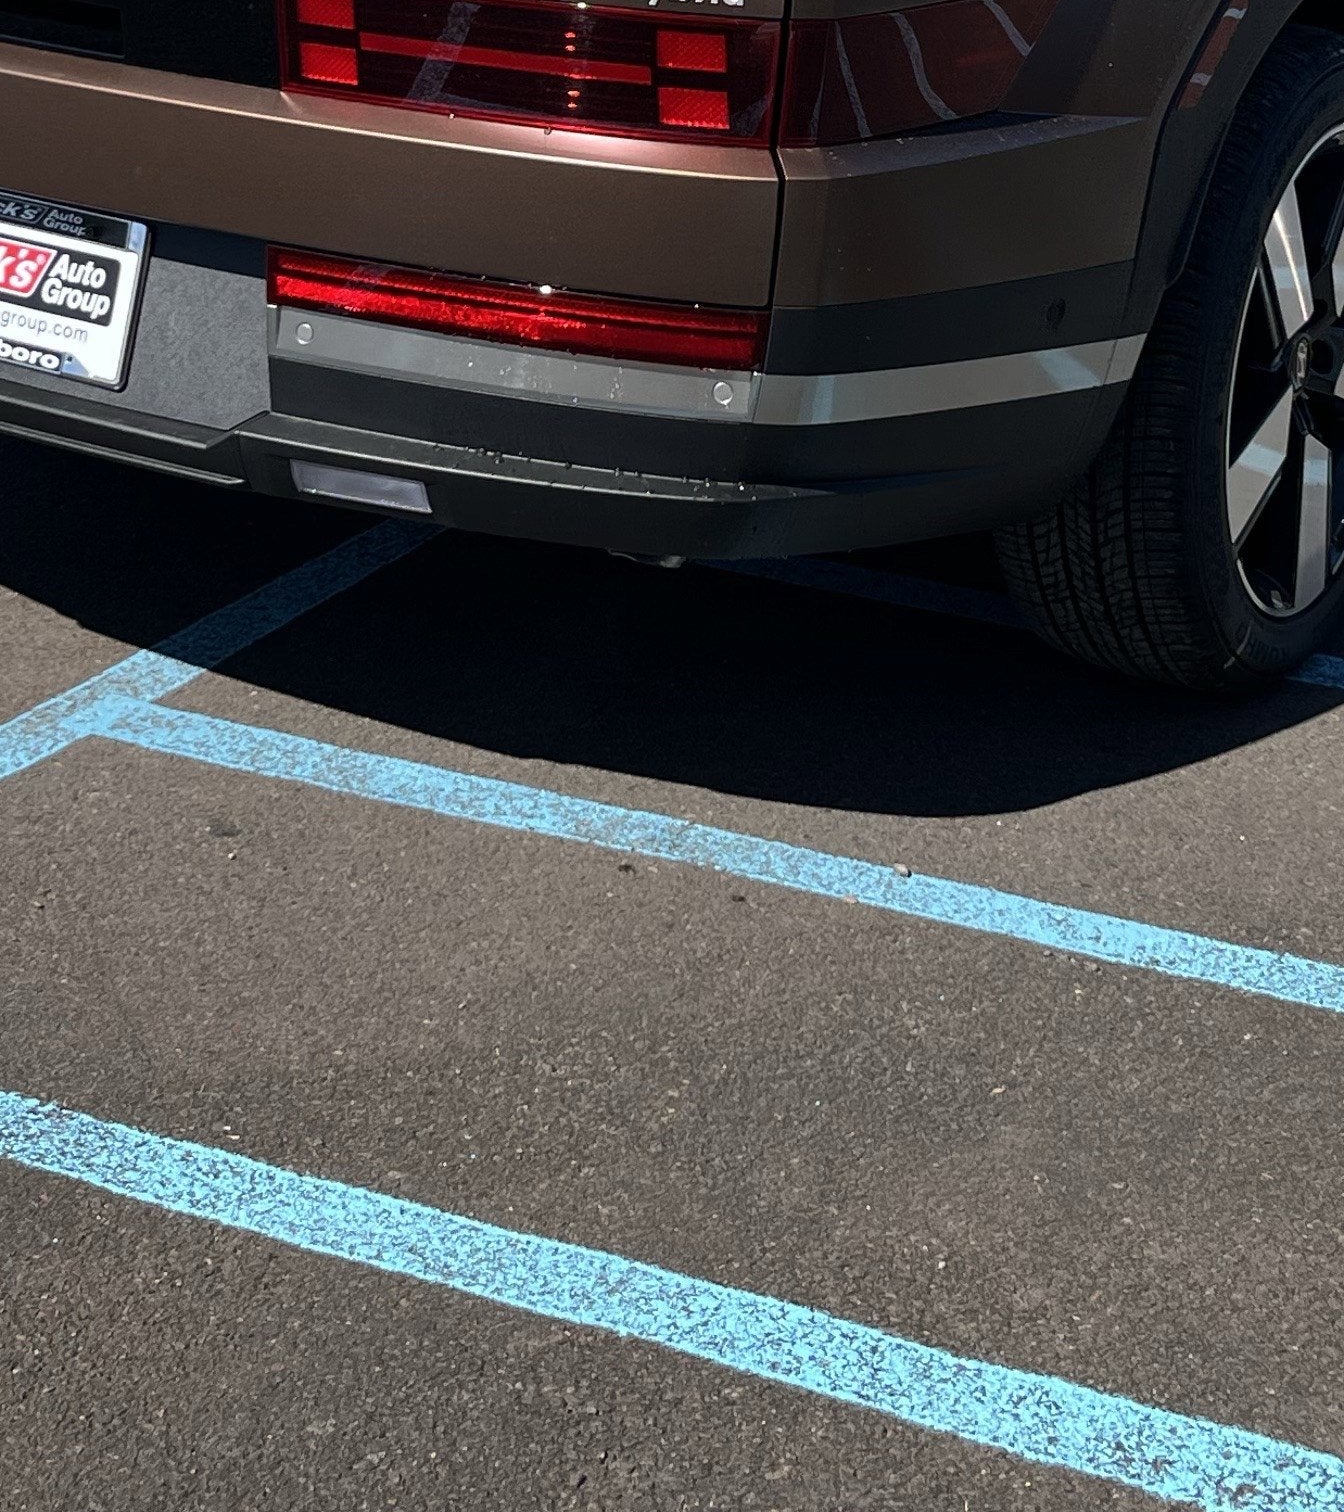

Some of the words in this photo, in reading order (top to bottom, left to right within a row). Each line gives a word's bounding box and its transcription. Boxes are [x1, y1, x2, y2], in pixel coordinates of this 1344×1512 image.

[47, 209, 84, 224] Auto
[49, 253, 107, 288] Auto
[40, 278, 111, 319] Group
